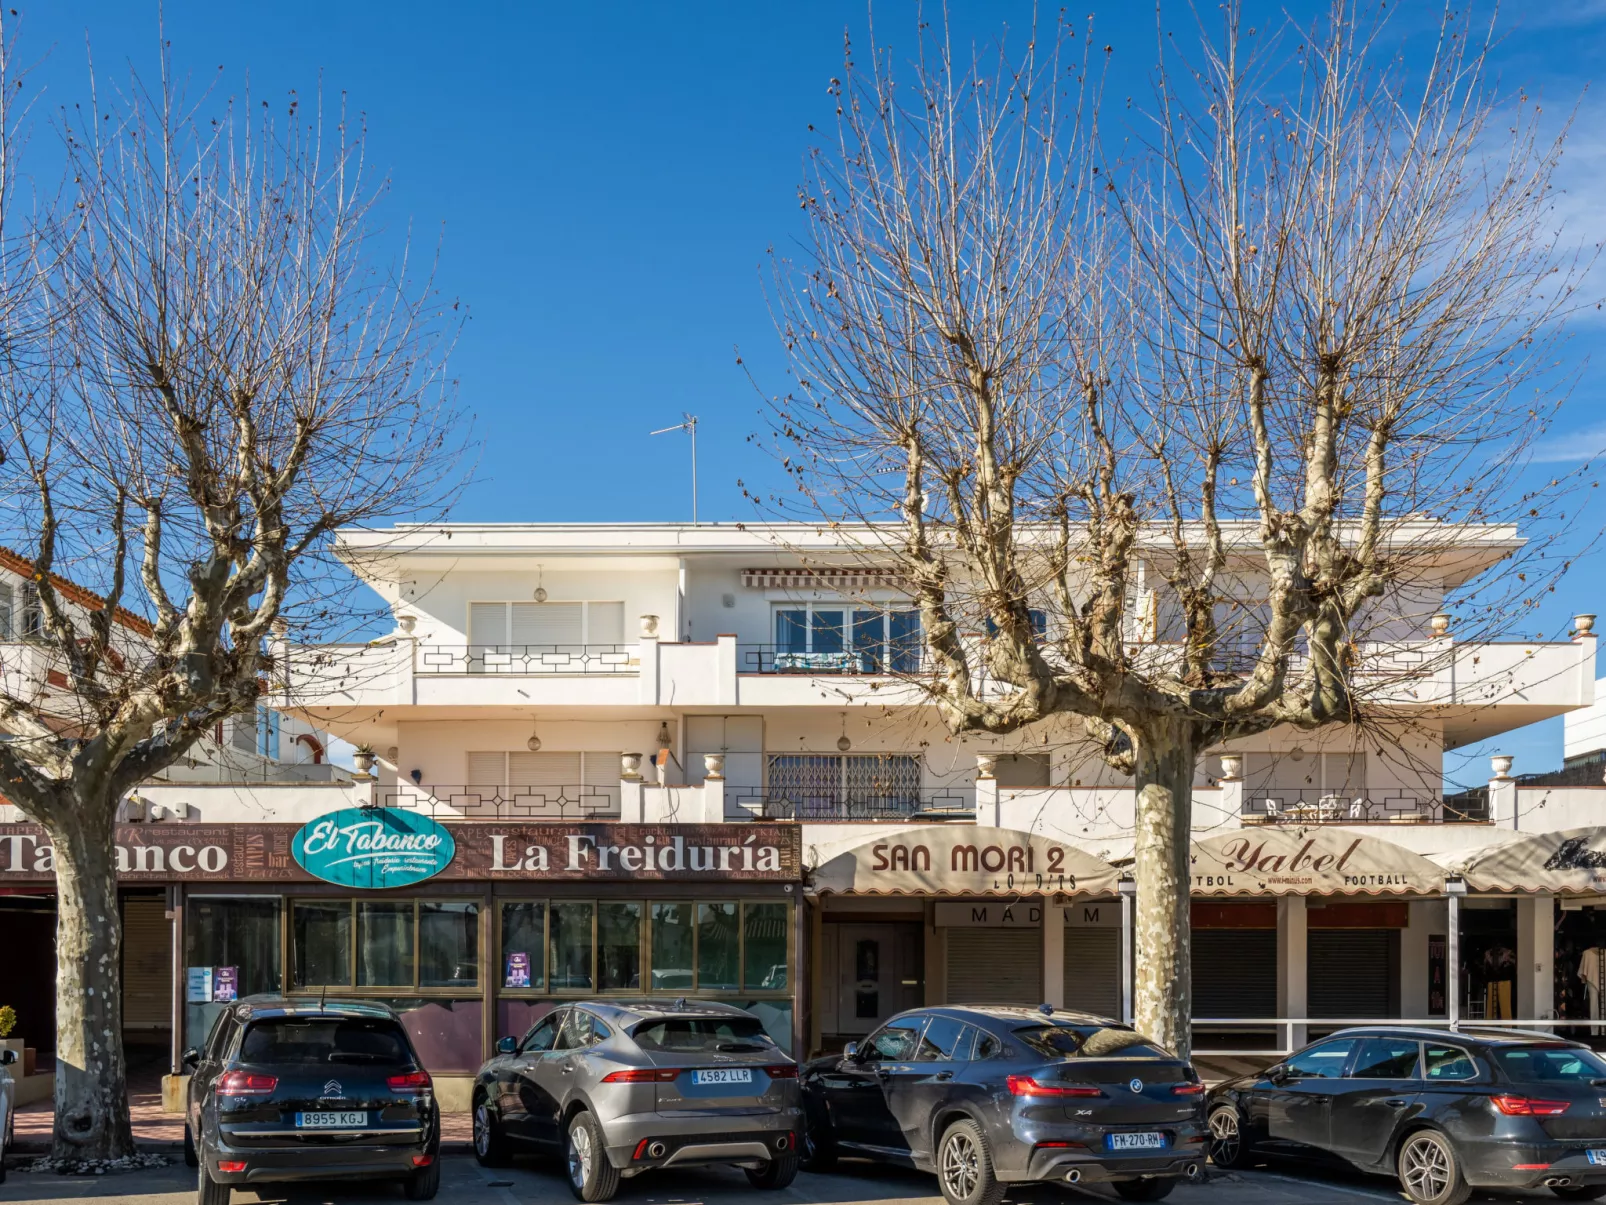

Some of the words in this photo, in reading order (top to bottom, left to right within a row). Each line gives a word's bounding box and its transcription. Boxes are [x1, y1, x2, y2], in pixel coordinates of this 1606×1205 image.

[145, 828, 230, 837] restaurant
[303, 820, 340, 855] El
[339, 821, 443, 854] Tabanco
[738, 828, 790, 837] COCKTAIL
[0, 835, 228, 873] Taanco
[268, 852, 290, 868] bar
[488, 834, 550, 871] La
[563, 834, 782, 872] Freiduría
[791, 827, 801, 878] restaurant
[872, 844, 931, 872] SAN
[951, 844, 1033, 873] MORI
[1046, 846, 1066, 873] 2
[1220, 837, 1364, 873] Yabel
[1189, 875, 1235, 887] TBOL
[1344, 874, 1408, 886] FOOTBALL
[700, 1072, 728, 1083] 4582
[730, 1071, 749, 1082] LLR
[304, 1113, 336, 1125] 8955
[340, 1113, 365, 1124] KGJ
